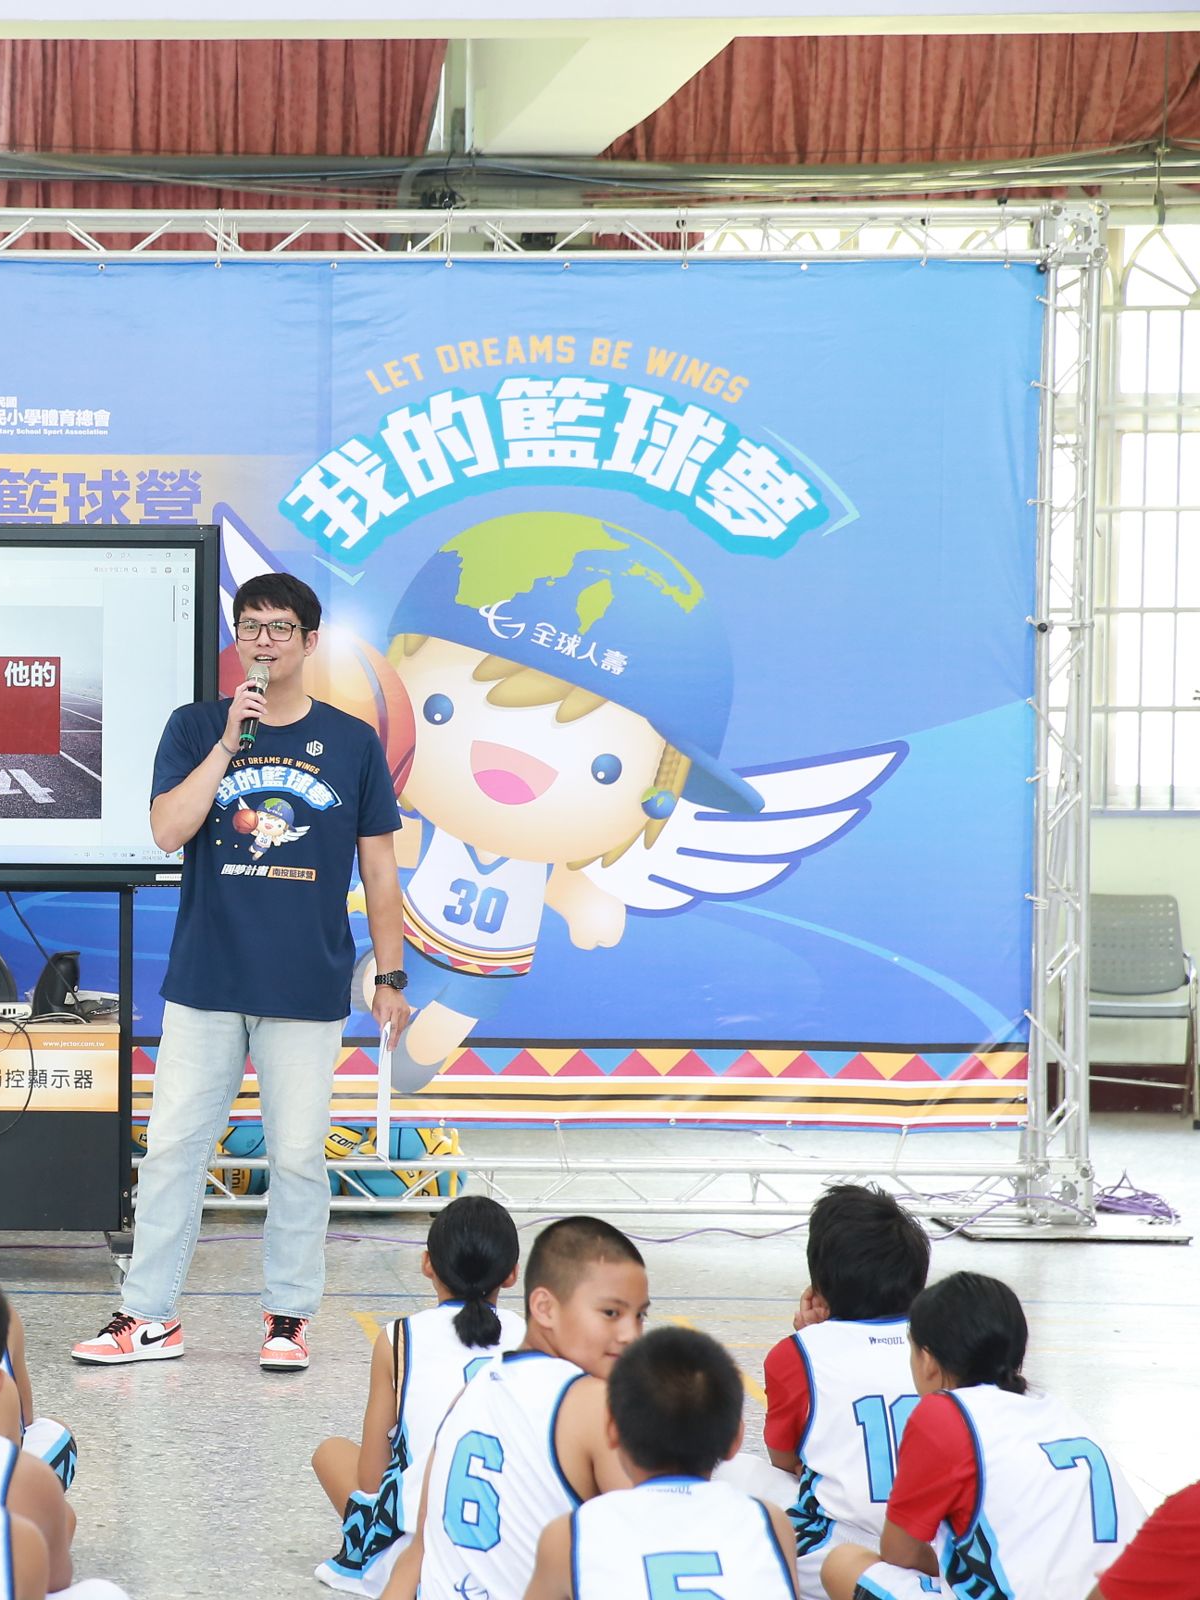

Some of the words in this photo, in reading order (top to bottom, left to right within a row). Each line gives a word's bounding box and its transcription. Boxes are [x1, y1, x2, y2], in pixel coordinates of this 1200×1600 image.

[366, 357, 424, 395] LET
[436, 335, 576, 373] DREAMS
[589, 338, 632, 369] BE
[646, 348, 750, 403] WINGS
[285, 377, 818, 549] 我的籃球夢
[531, 621, 630, 676] 全球人壽
[217, 766, 335, 807] 我的籃球夢
[232, 758, 246, 768] LET
[248, 756, 280, 765] DREAMS
[295, 761, 320, 774] WINGS
[442, 878, 509, 934] 30
[443, 1430, 504, 1552] 6
[1038, 1437, 1118, 1543] 7
